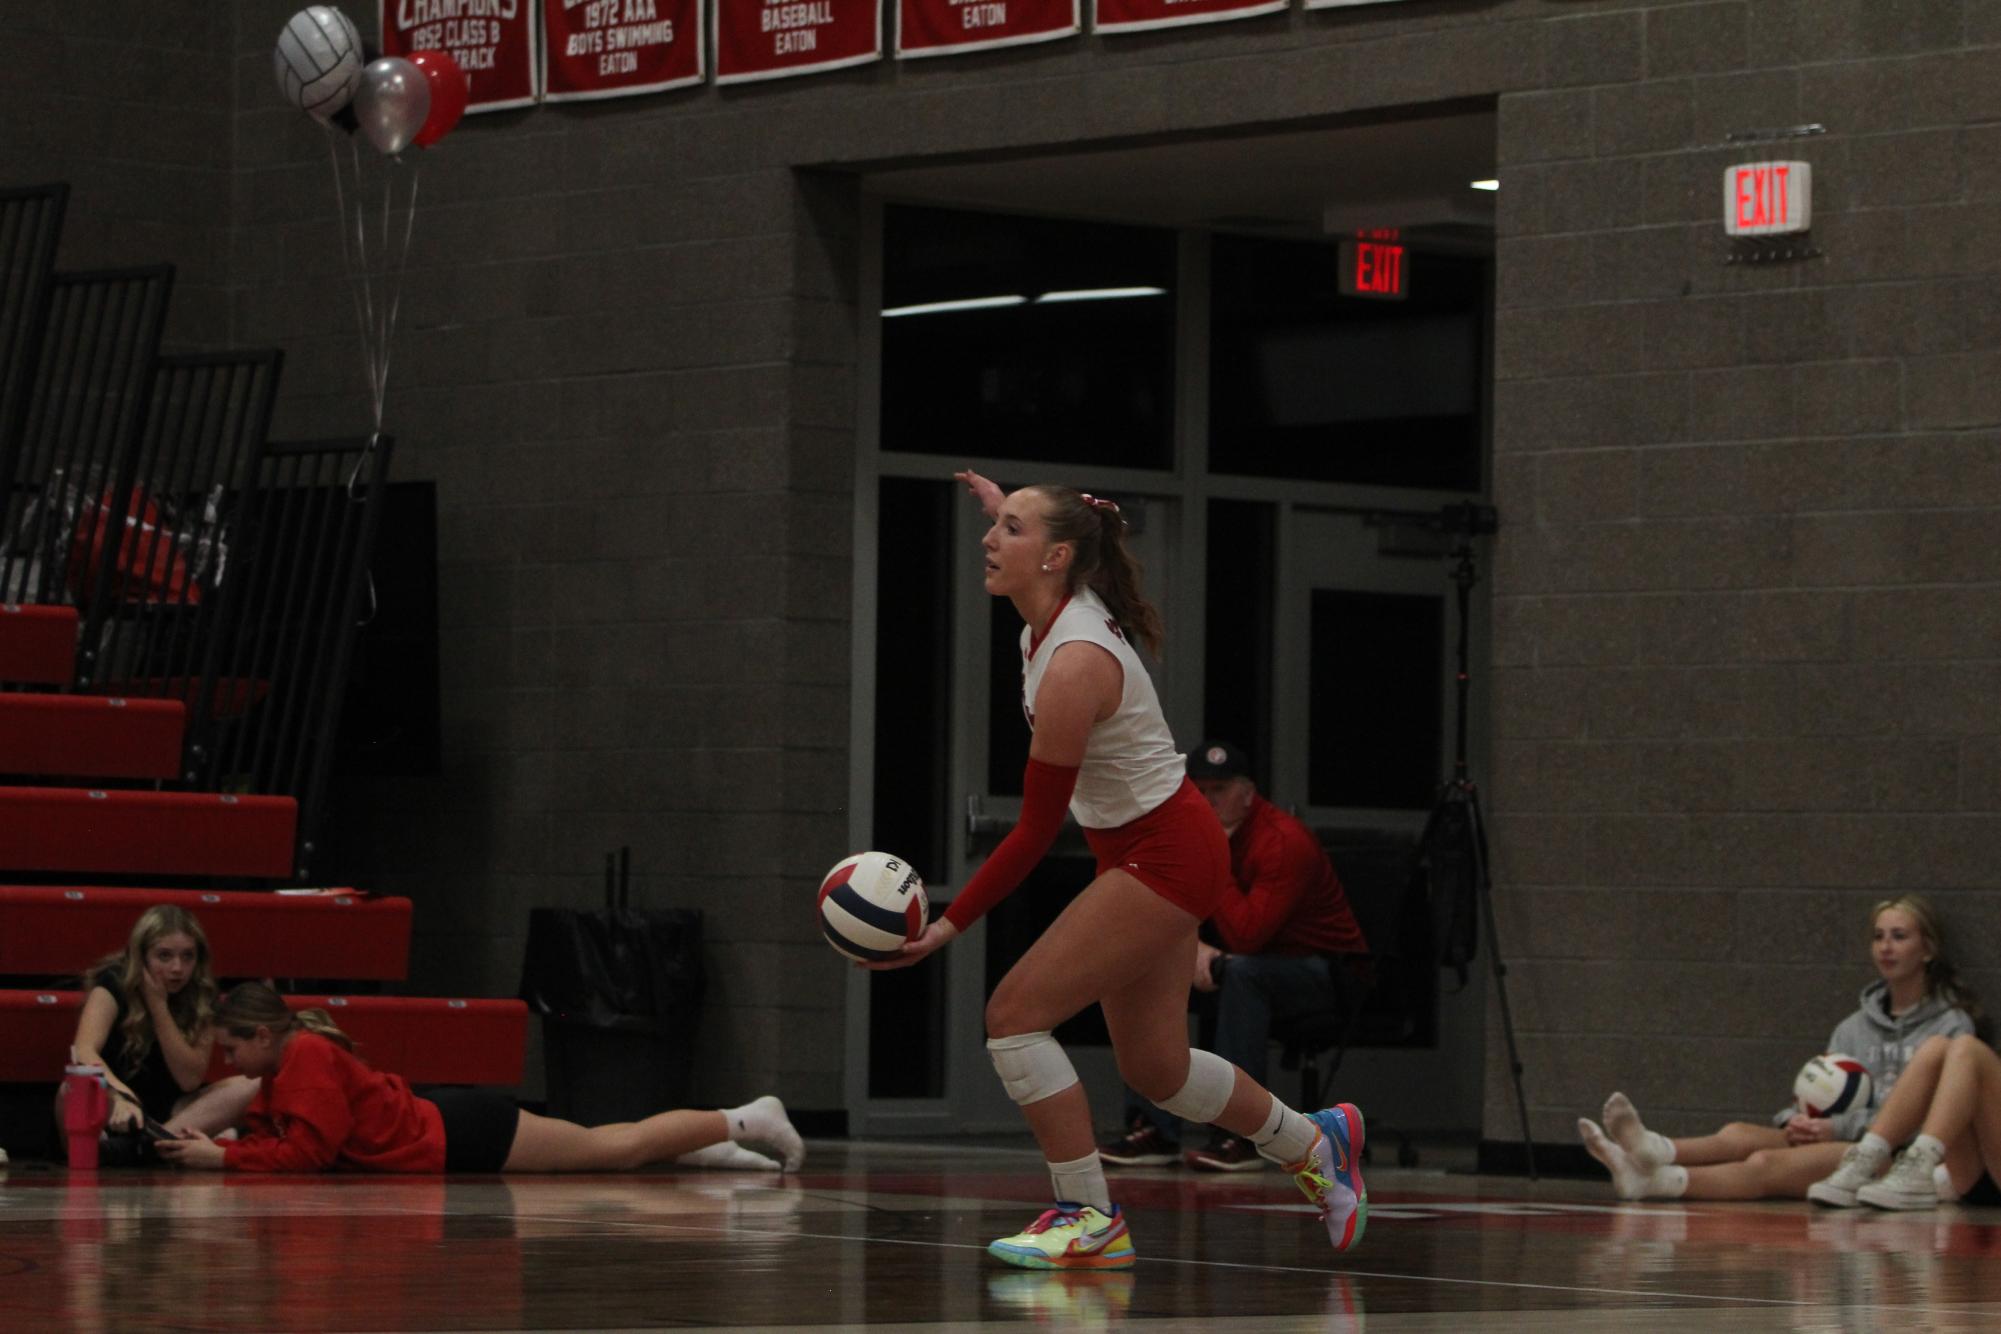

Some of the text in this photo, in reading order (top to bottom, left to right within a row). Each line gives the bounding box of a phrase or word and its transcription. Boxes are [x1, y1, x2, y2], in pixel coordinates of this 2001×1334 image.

[397, 0, 518, 32] CHAMPIONS
[584, 0, 657, 29] 1972 AAA
[761, 1, 834, 33] BASEBALL
[962, 3, 1006, 30] EATON
[412, 19, 500, 50] 1952 CLASS B
[565, 19, 674, 56] BOYS SWIMMING
[774, 29, 817, 56] EATON
[453, 46, 496, 70] TRACK
[598, 50, 638, 76] EATON
[1736, 167, 1789, 228] EXIT
[1356, 242, 1403, 295] EXIT
